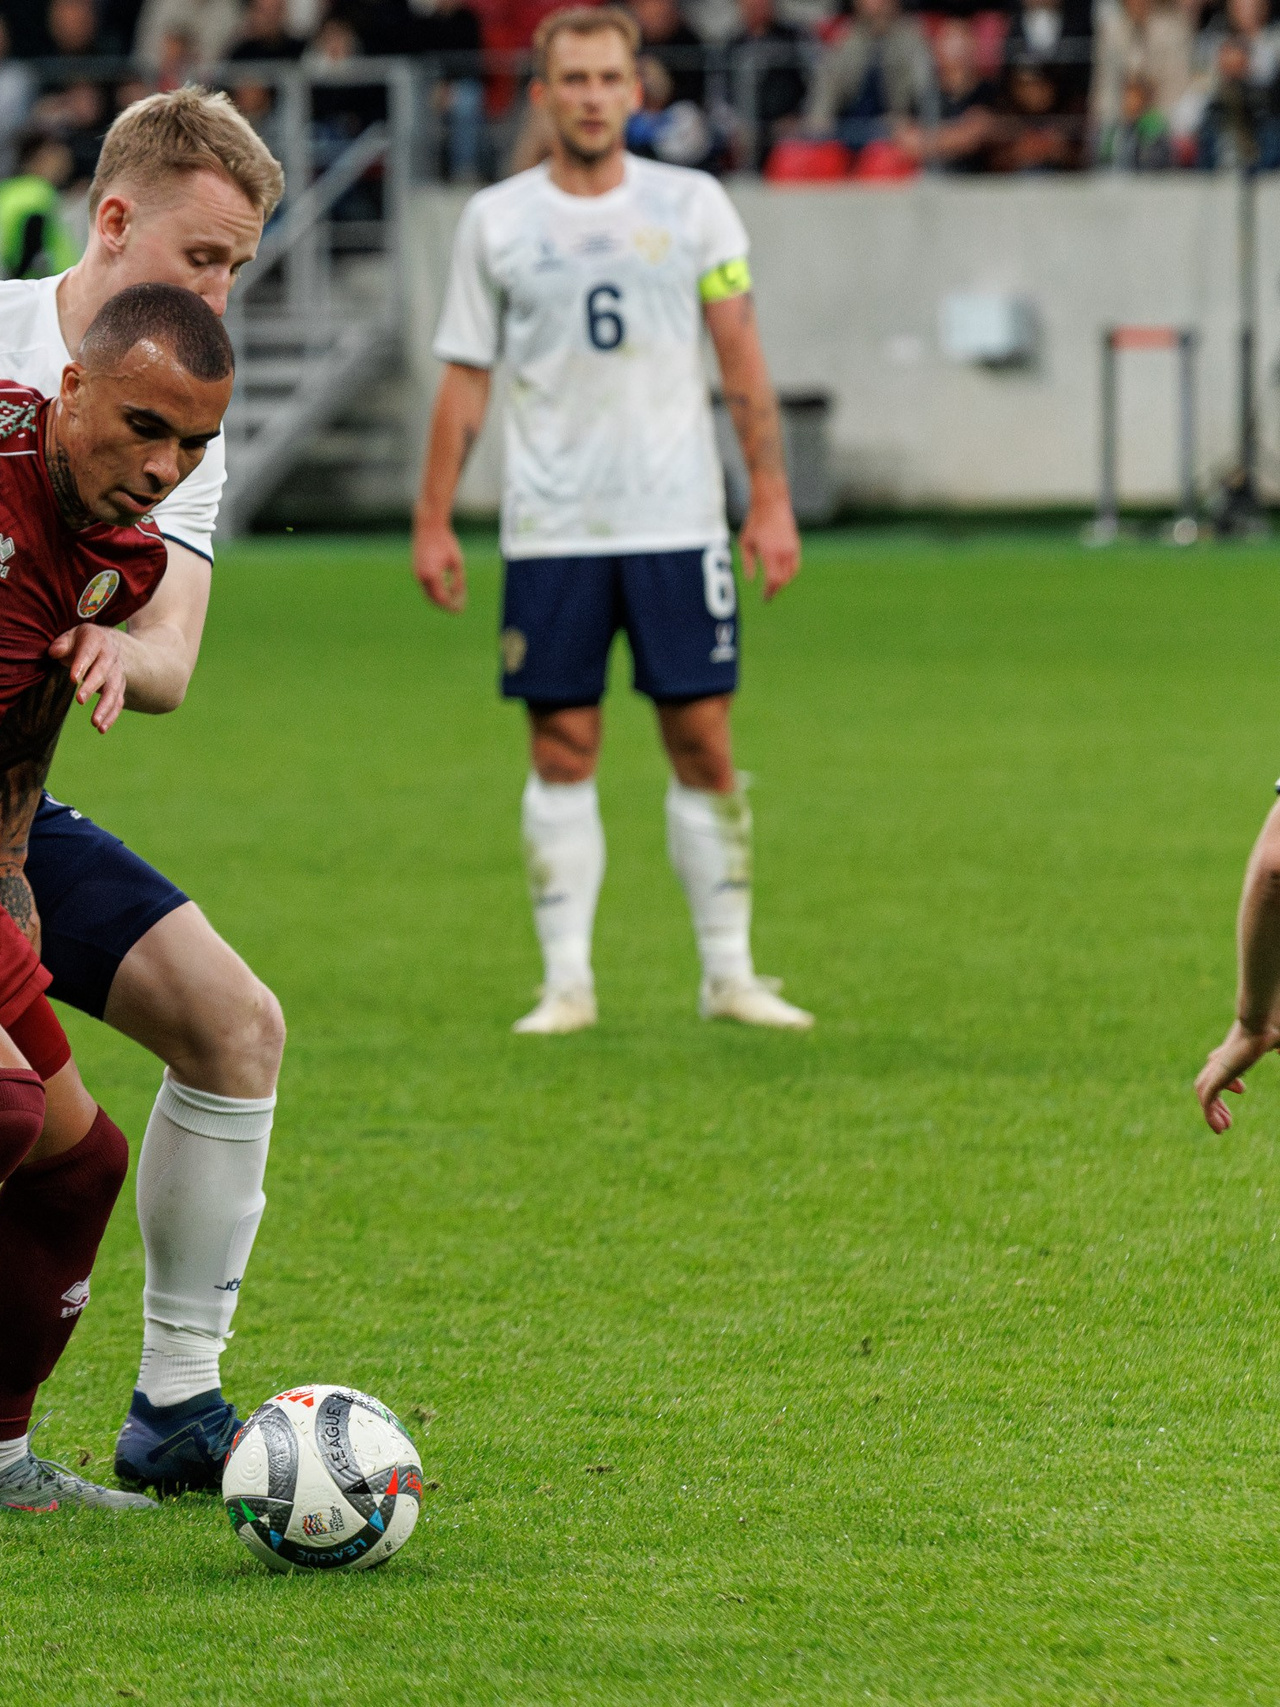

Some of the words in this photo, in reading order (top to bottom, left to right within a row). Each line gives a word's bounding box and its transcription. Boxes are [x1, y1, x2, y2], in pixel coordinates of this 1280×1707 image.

[586, 283, 625, 351] 6
[702, 546, 737, 619] 6
[325, 1407, 350, 1473] LEAGUE
